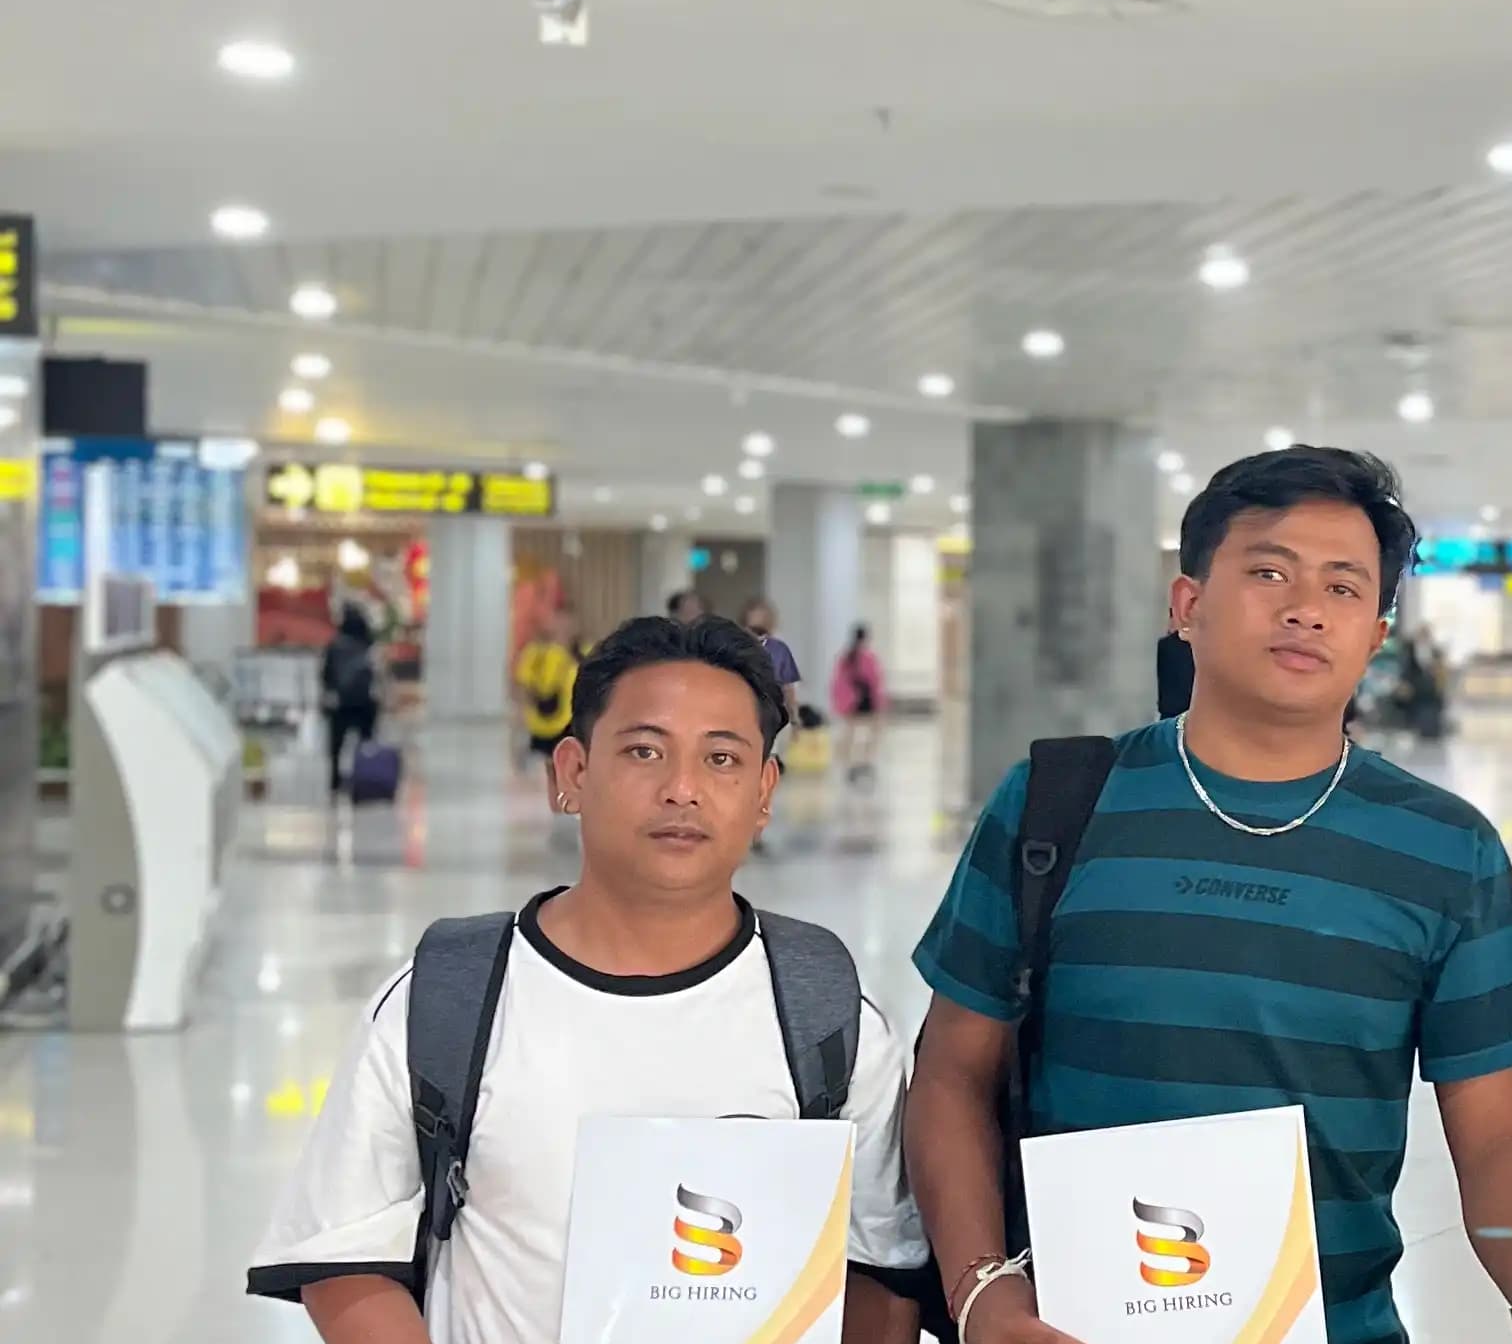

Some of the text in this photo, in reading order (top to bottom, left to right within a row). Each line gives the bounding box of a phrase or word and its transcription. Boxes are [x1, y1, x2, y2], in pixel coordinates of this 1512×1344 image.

[1195, 877, 1292, 906] CONVERSE
[649, 1284, 758, 1302] BIG HIRING
[1124, 1291, 1233, 1316] BIG HIRING
